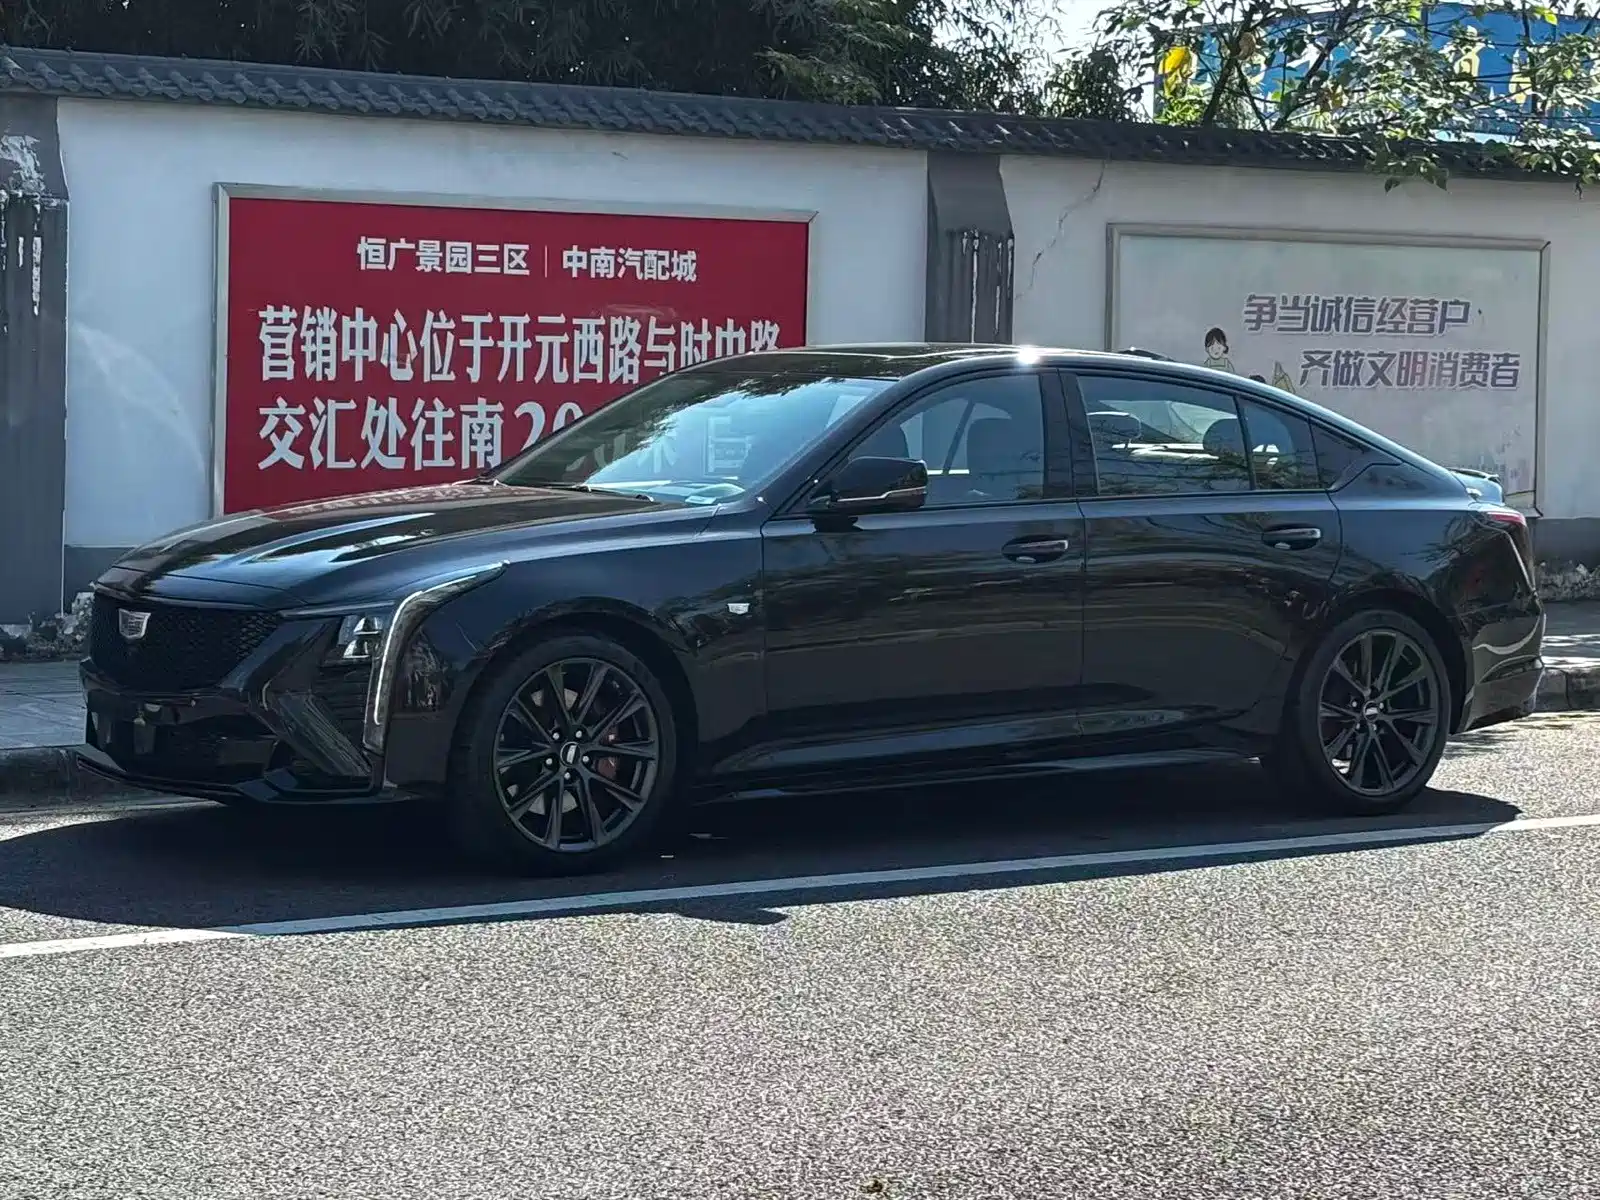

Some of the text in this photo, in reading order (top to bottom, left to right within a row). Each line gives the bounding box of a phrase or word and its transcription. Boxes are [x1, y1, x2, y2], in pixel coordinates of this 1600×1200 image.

[356, 235, 698, 282] 恒广景园三区 中南汽配城
[1244, 293, 1472, 335] 争当诚信经营户
[1300, 348, 1522, 389] 齐做文明消费者
